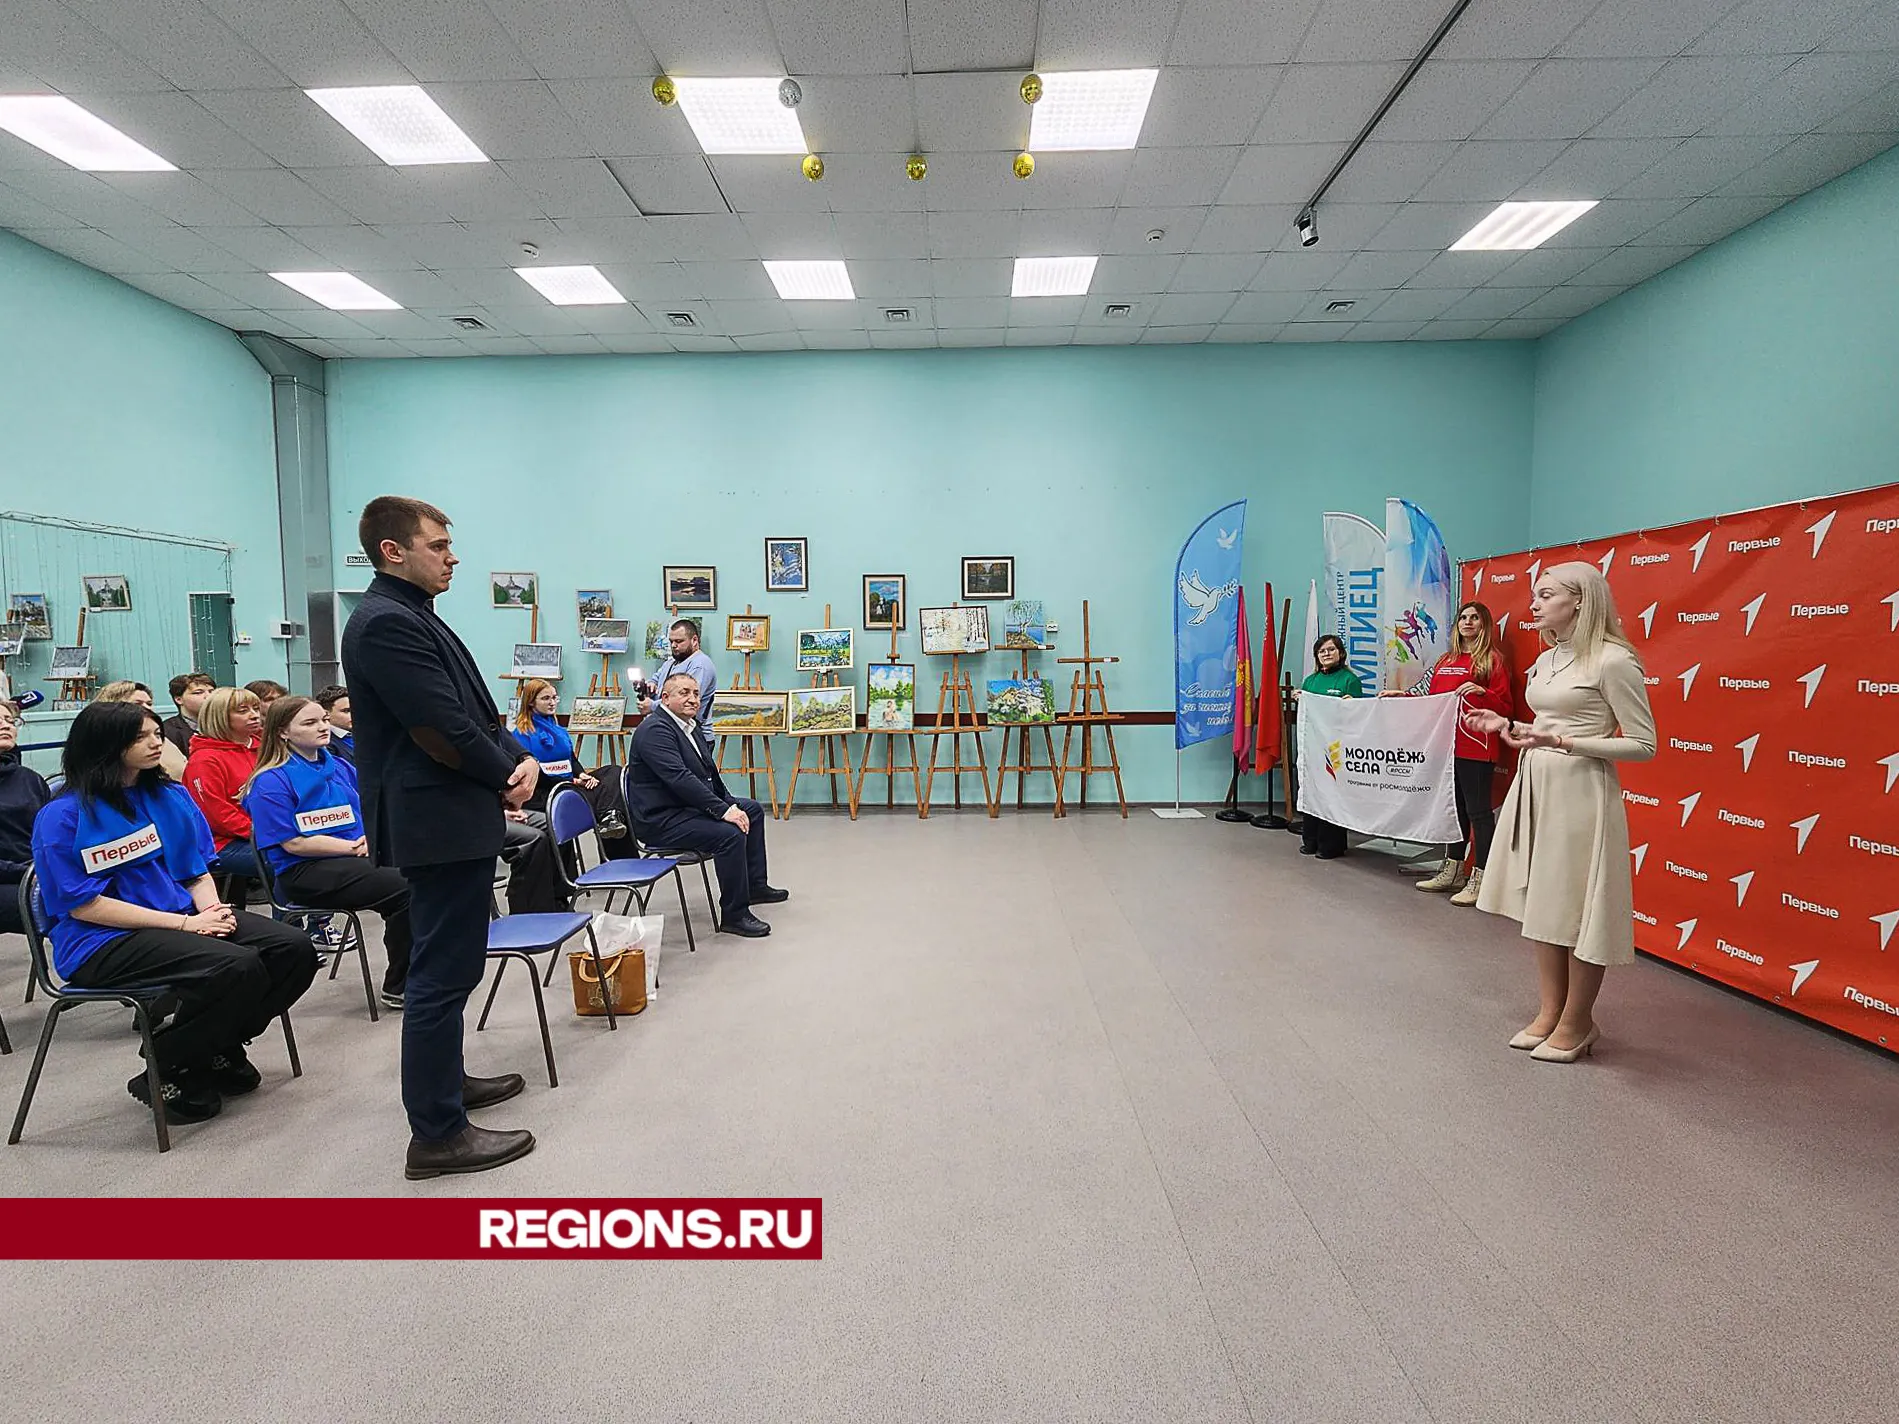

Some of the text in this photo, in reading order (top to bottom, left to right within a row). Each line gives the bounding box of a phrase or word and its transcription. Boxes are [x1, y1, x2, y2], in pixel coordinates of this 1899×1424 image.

[1729, 536, 1781, 553] Первые
[1630, 552, 1669, 566] Первые
[1336, 571, 1346, 604] ЦЕНТР
[1678, 611, 1719, 624] Первые
[1790, 604, 1849, 618] Первые
[1350, 568, 1384, 697] МПИЕЦ
[1719, 676, 1770, 690] Первые
[1670, 737, 1713, 752] Первые
[1345, 761, 1380, 774] СЕЛА
[1788, 751, 1846, 768] Первые
[1622, 790, 1659, 806] Первые
[302, 812, 350, 827] Первые
[1718, 809, 1765, 829] Первые
[91, 835, 157, 865] Первые
[1665, 861, 1708, 882] Первые
[1782, 893, 1839, 919] Первые
[1716, 939, 1764, 965] Первые
